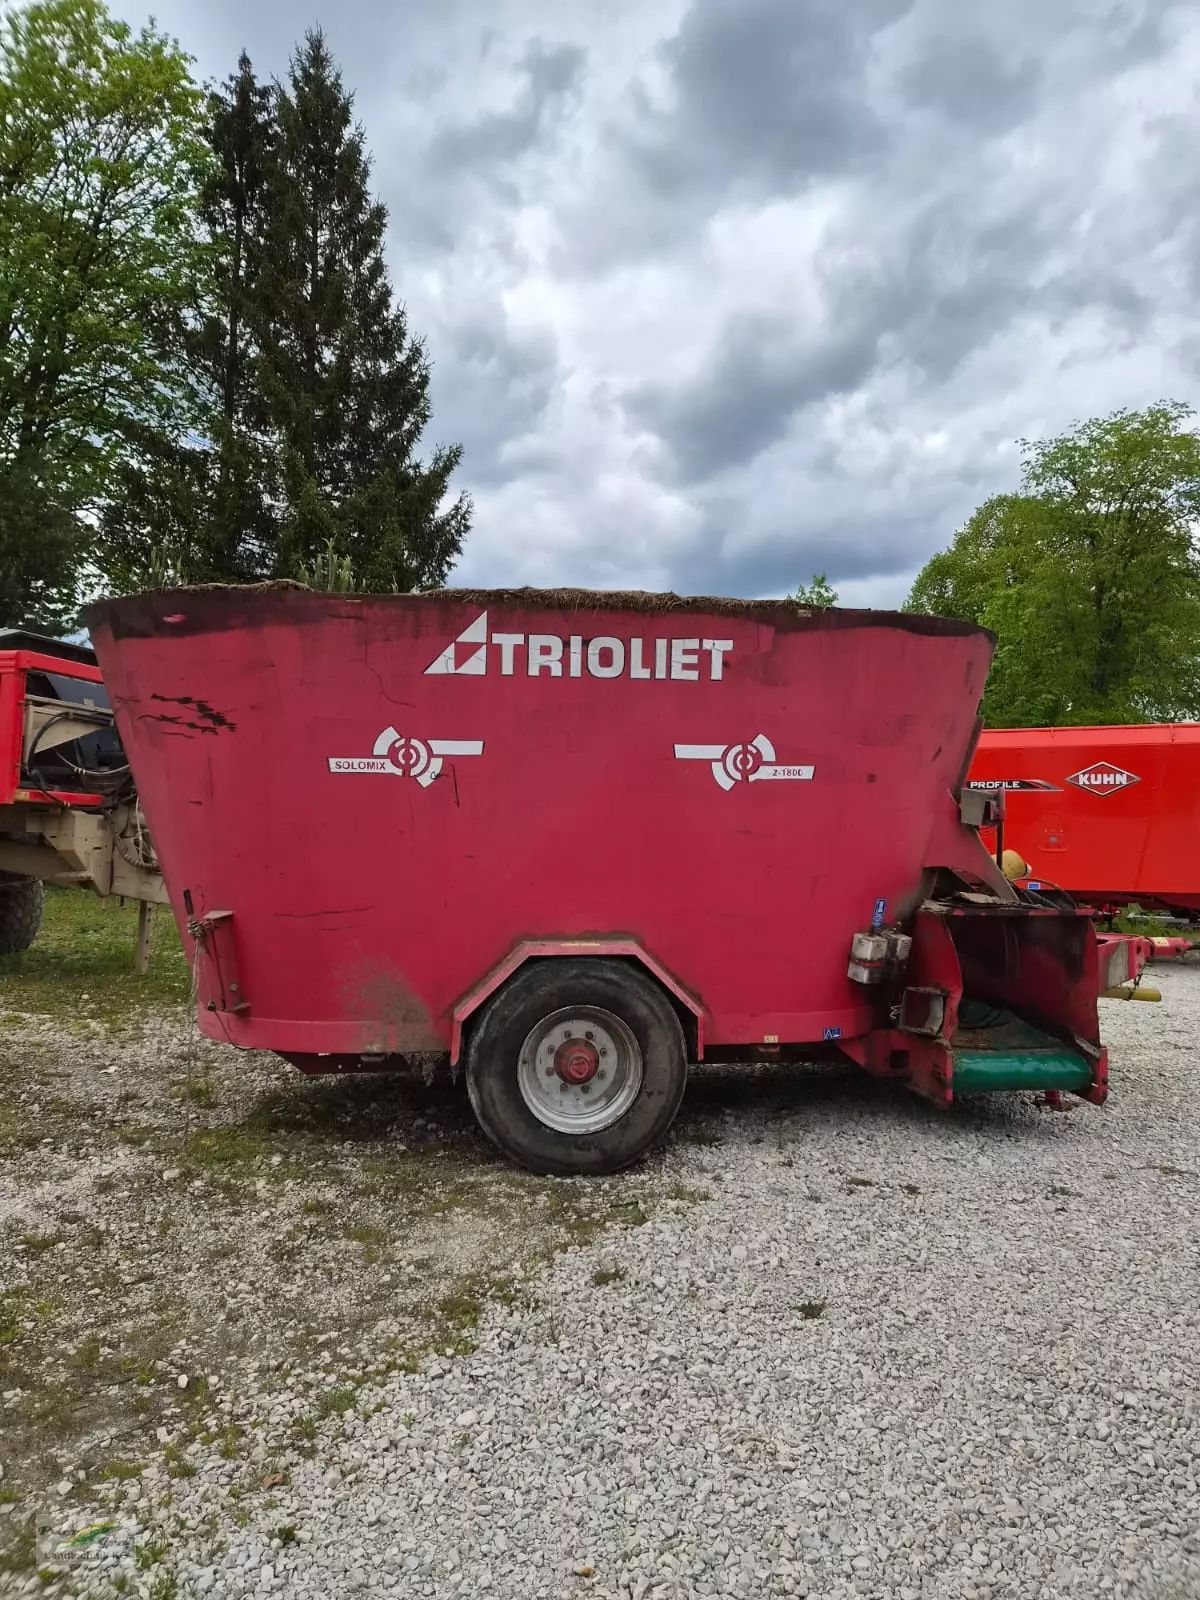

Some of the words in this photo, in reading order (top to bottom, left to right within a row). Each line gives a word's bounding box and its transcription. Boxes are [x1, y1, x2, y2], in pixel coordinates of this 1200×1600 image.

[492, 633, 734, 681] TRIOLIET
[335, 761, 387, 771] SOLOMIX
[772, 768, 804, 777] 2-1800
[1078, 773, 1128, 786] KUHN
[970, 781, 1021, 789] PROFILE
